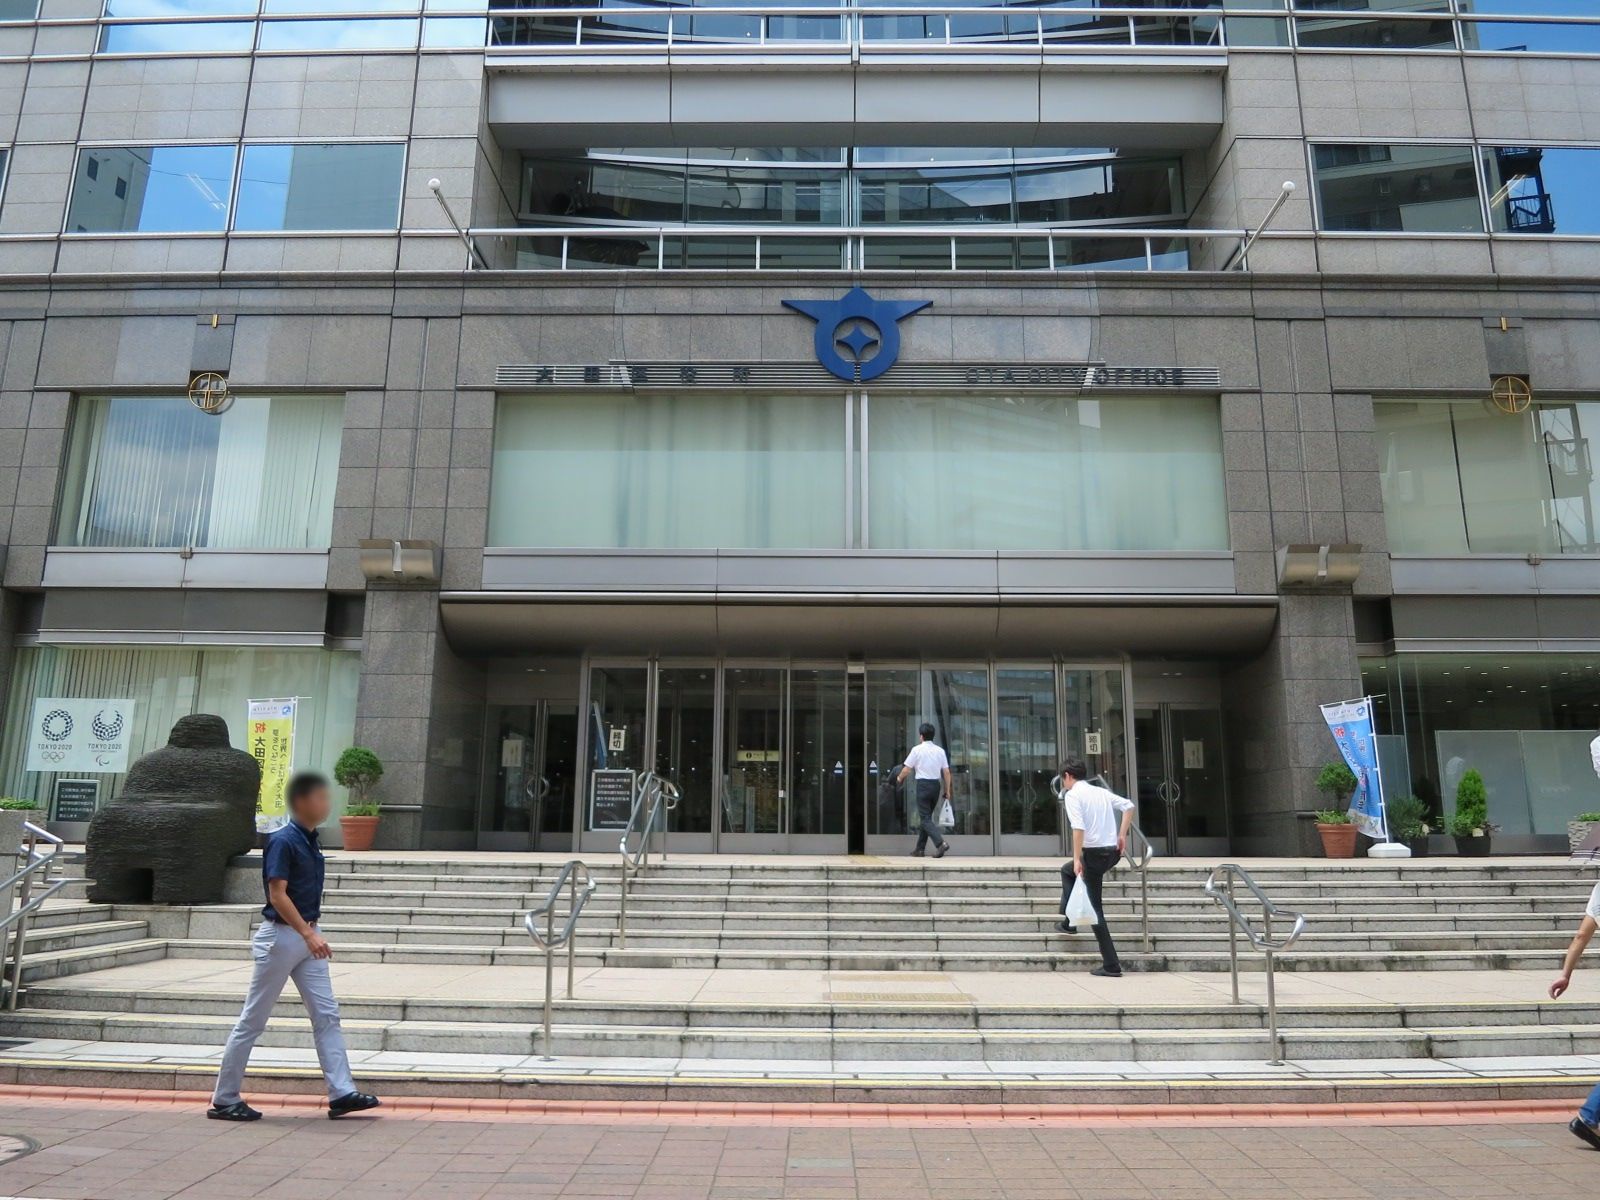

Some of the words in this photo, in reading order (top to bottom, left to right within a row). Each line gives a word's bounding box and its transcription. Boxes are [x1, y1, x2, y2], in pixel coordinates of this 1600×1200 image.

[965, 367, 1016, 385] OTA
[1027, 367, 1085, 385] CITY
[1093, 367, 1185, 385] OFFICE
